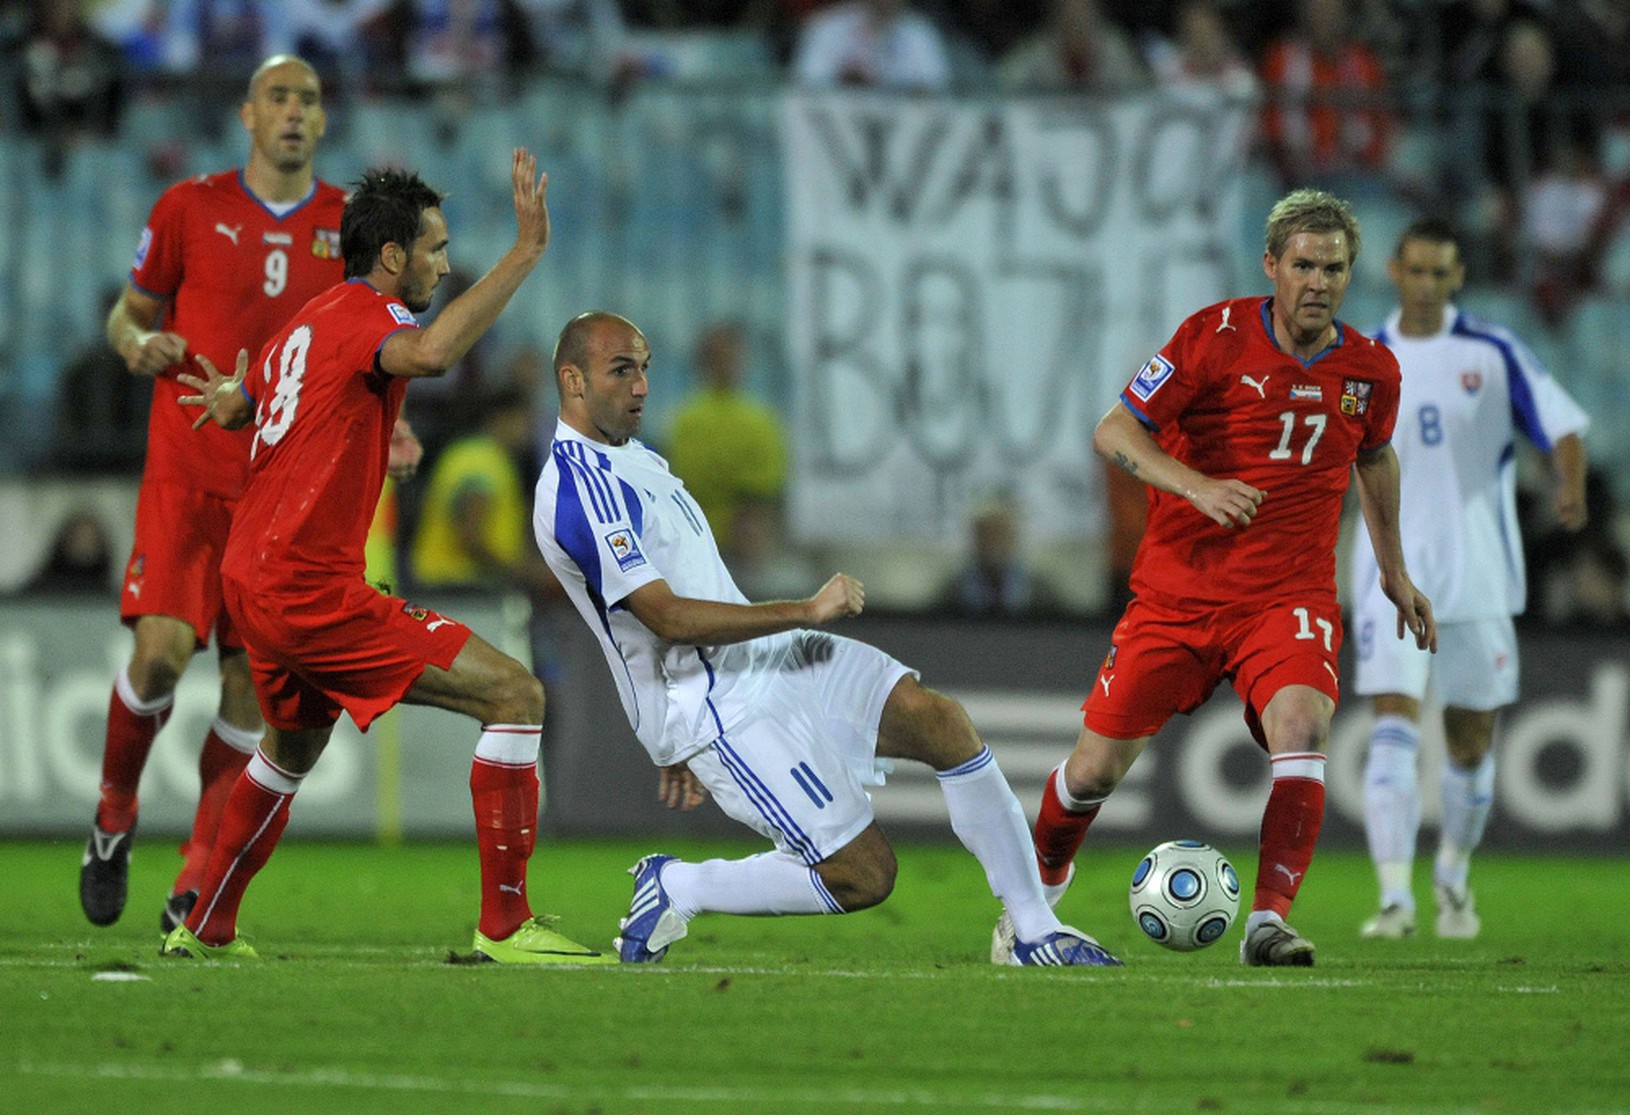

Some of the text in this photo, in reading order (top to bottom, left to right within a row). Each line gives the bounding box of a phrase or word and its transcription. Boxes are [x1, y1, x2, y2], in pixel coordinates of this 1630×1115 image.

[263, 249, 288, 298] 9
[1268, 411, 1327, 465] 17
[1418, 403, 1445, 447] 8
[1293, 607, 1333, 652] 17
[790, 761, 834, 809] 11
